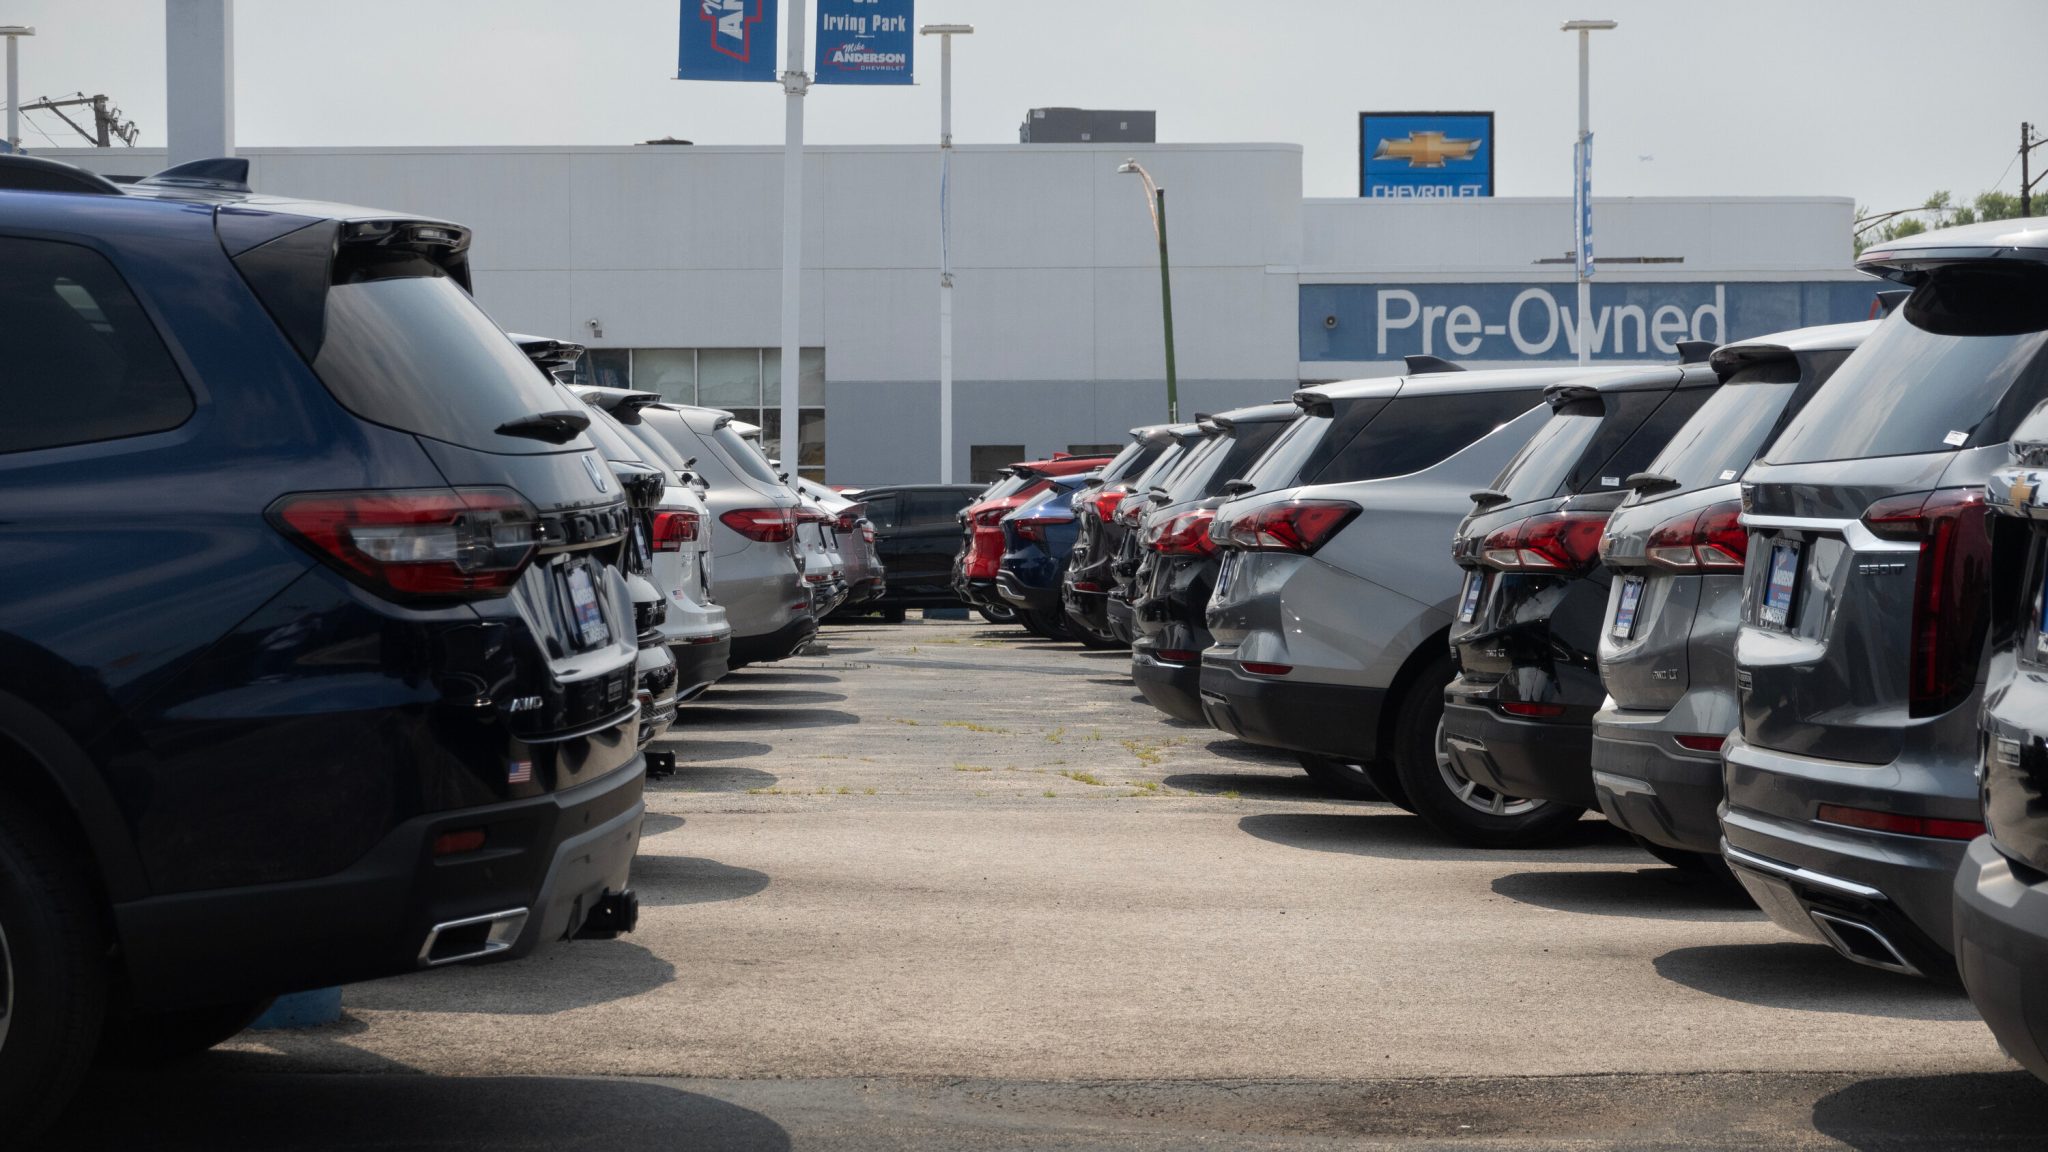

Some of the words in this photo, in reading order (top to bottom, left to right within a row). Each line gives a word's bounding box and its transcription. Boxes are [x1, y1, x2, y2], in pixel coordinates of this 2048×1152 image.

[823, 13, 866, 34] Irving
[873, 14, 906, 32] Park
[842, 42, 865, 53] Mike
[832, 50, 906, 63] ANDERSON
[1377, 284, 1726, 355] Pre-Owned
